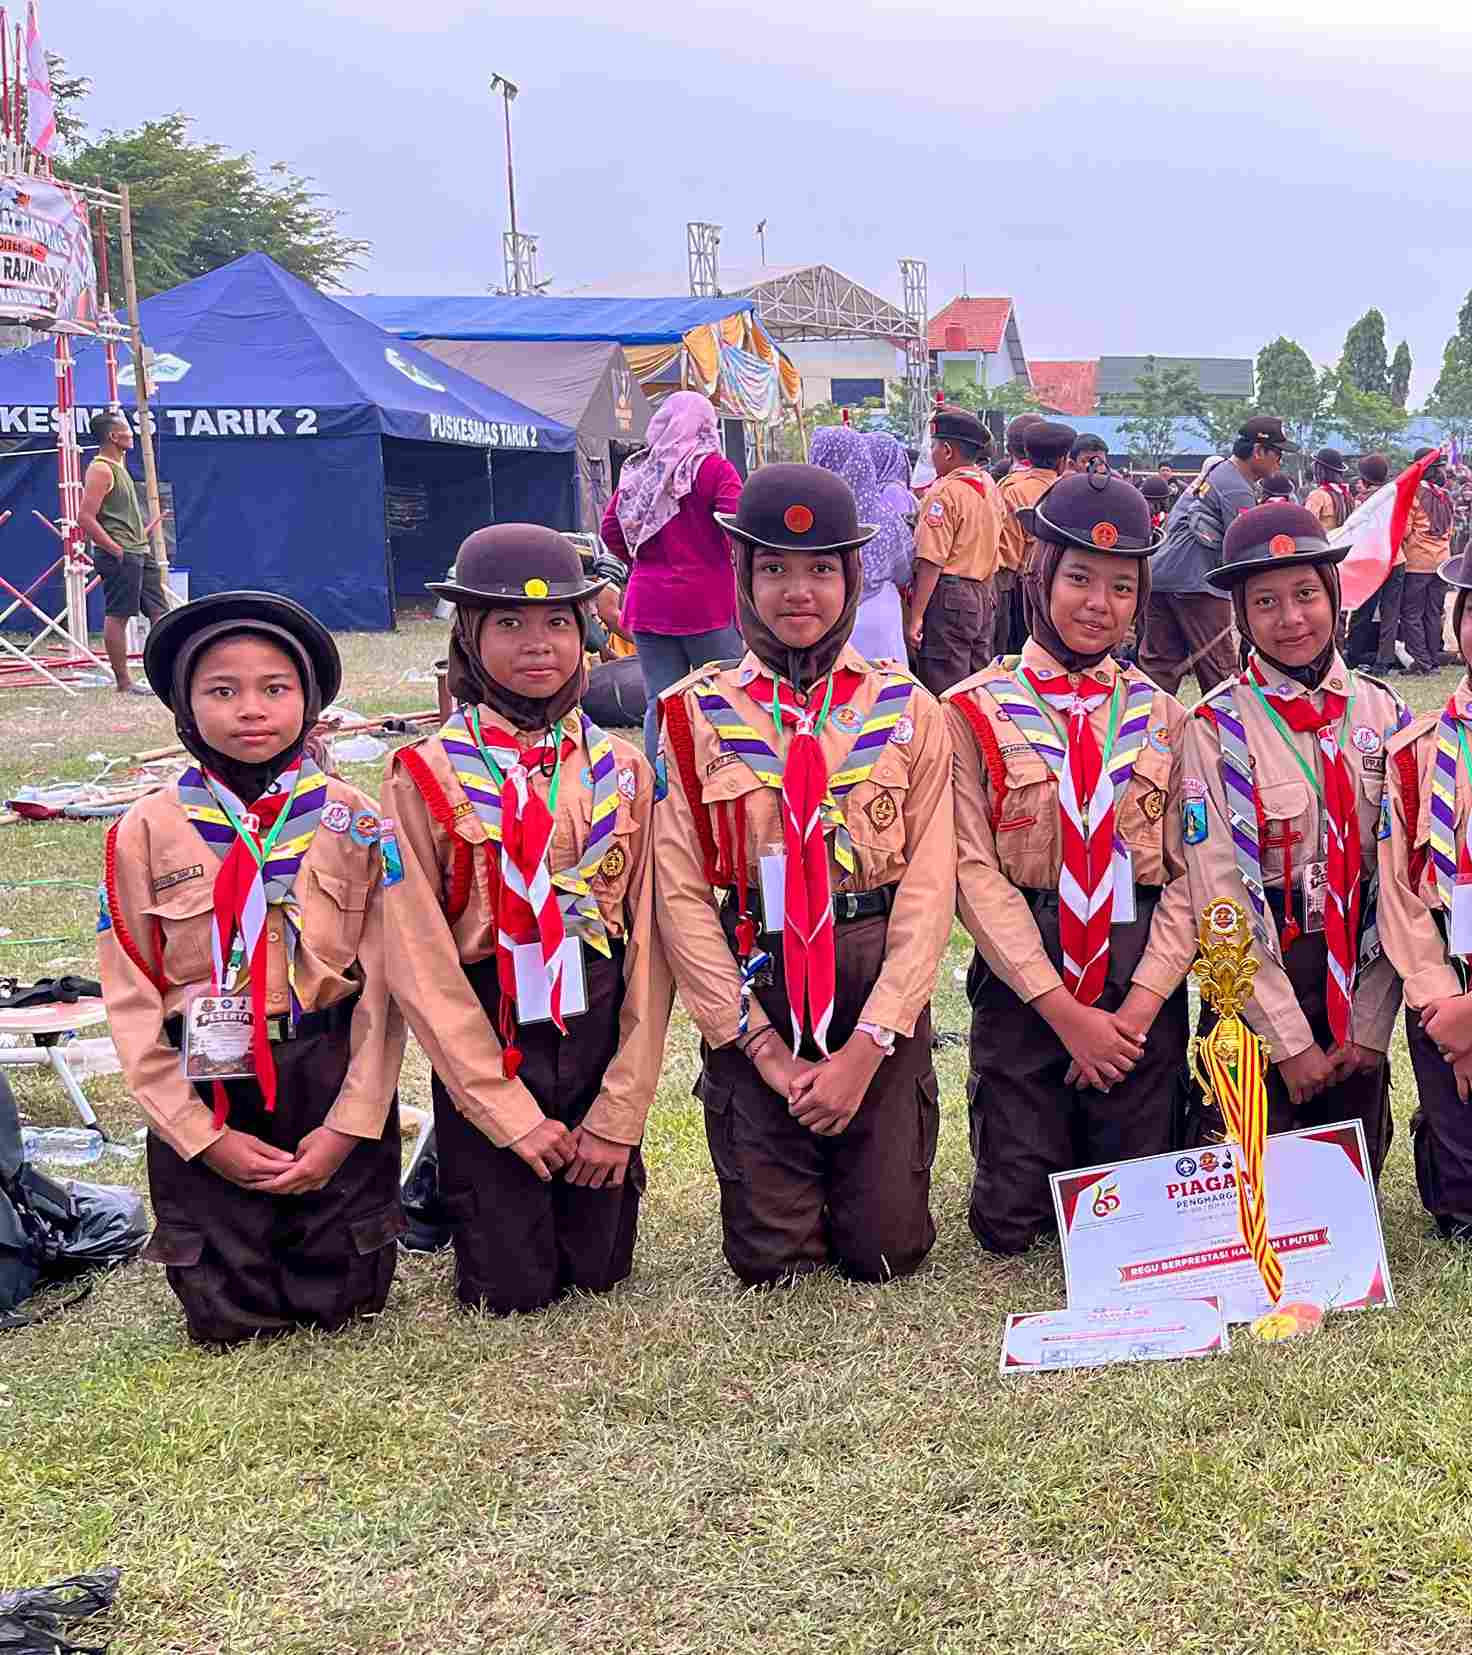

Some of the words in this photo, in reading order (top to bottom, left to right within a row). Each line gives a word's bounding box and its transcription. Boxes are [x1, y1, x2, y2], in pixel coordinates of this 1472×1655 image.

[168, 409, 285, 436] TARIK
[296, 409, 317, 434] 2
[430, 414, 498, 446] PUSKESMAS
[499, 423, 529, 447] TARIK
[530, 426, 537, 447] 2
[202, 1013, 250, 1024] PESERTA
[1131, 1262, 1159, 1276] REGU
[1161, 1250, 1229, 1271] BERPRESTASI
[1289, 1232, 1318, 1246] PUTRI
